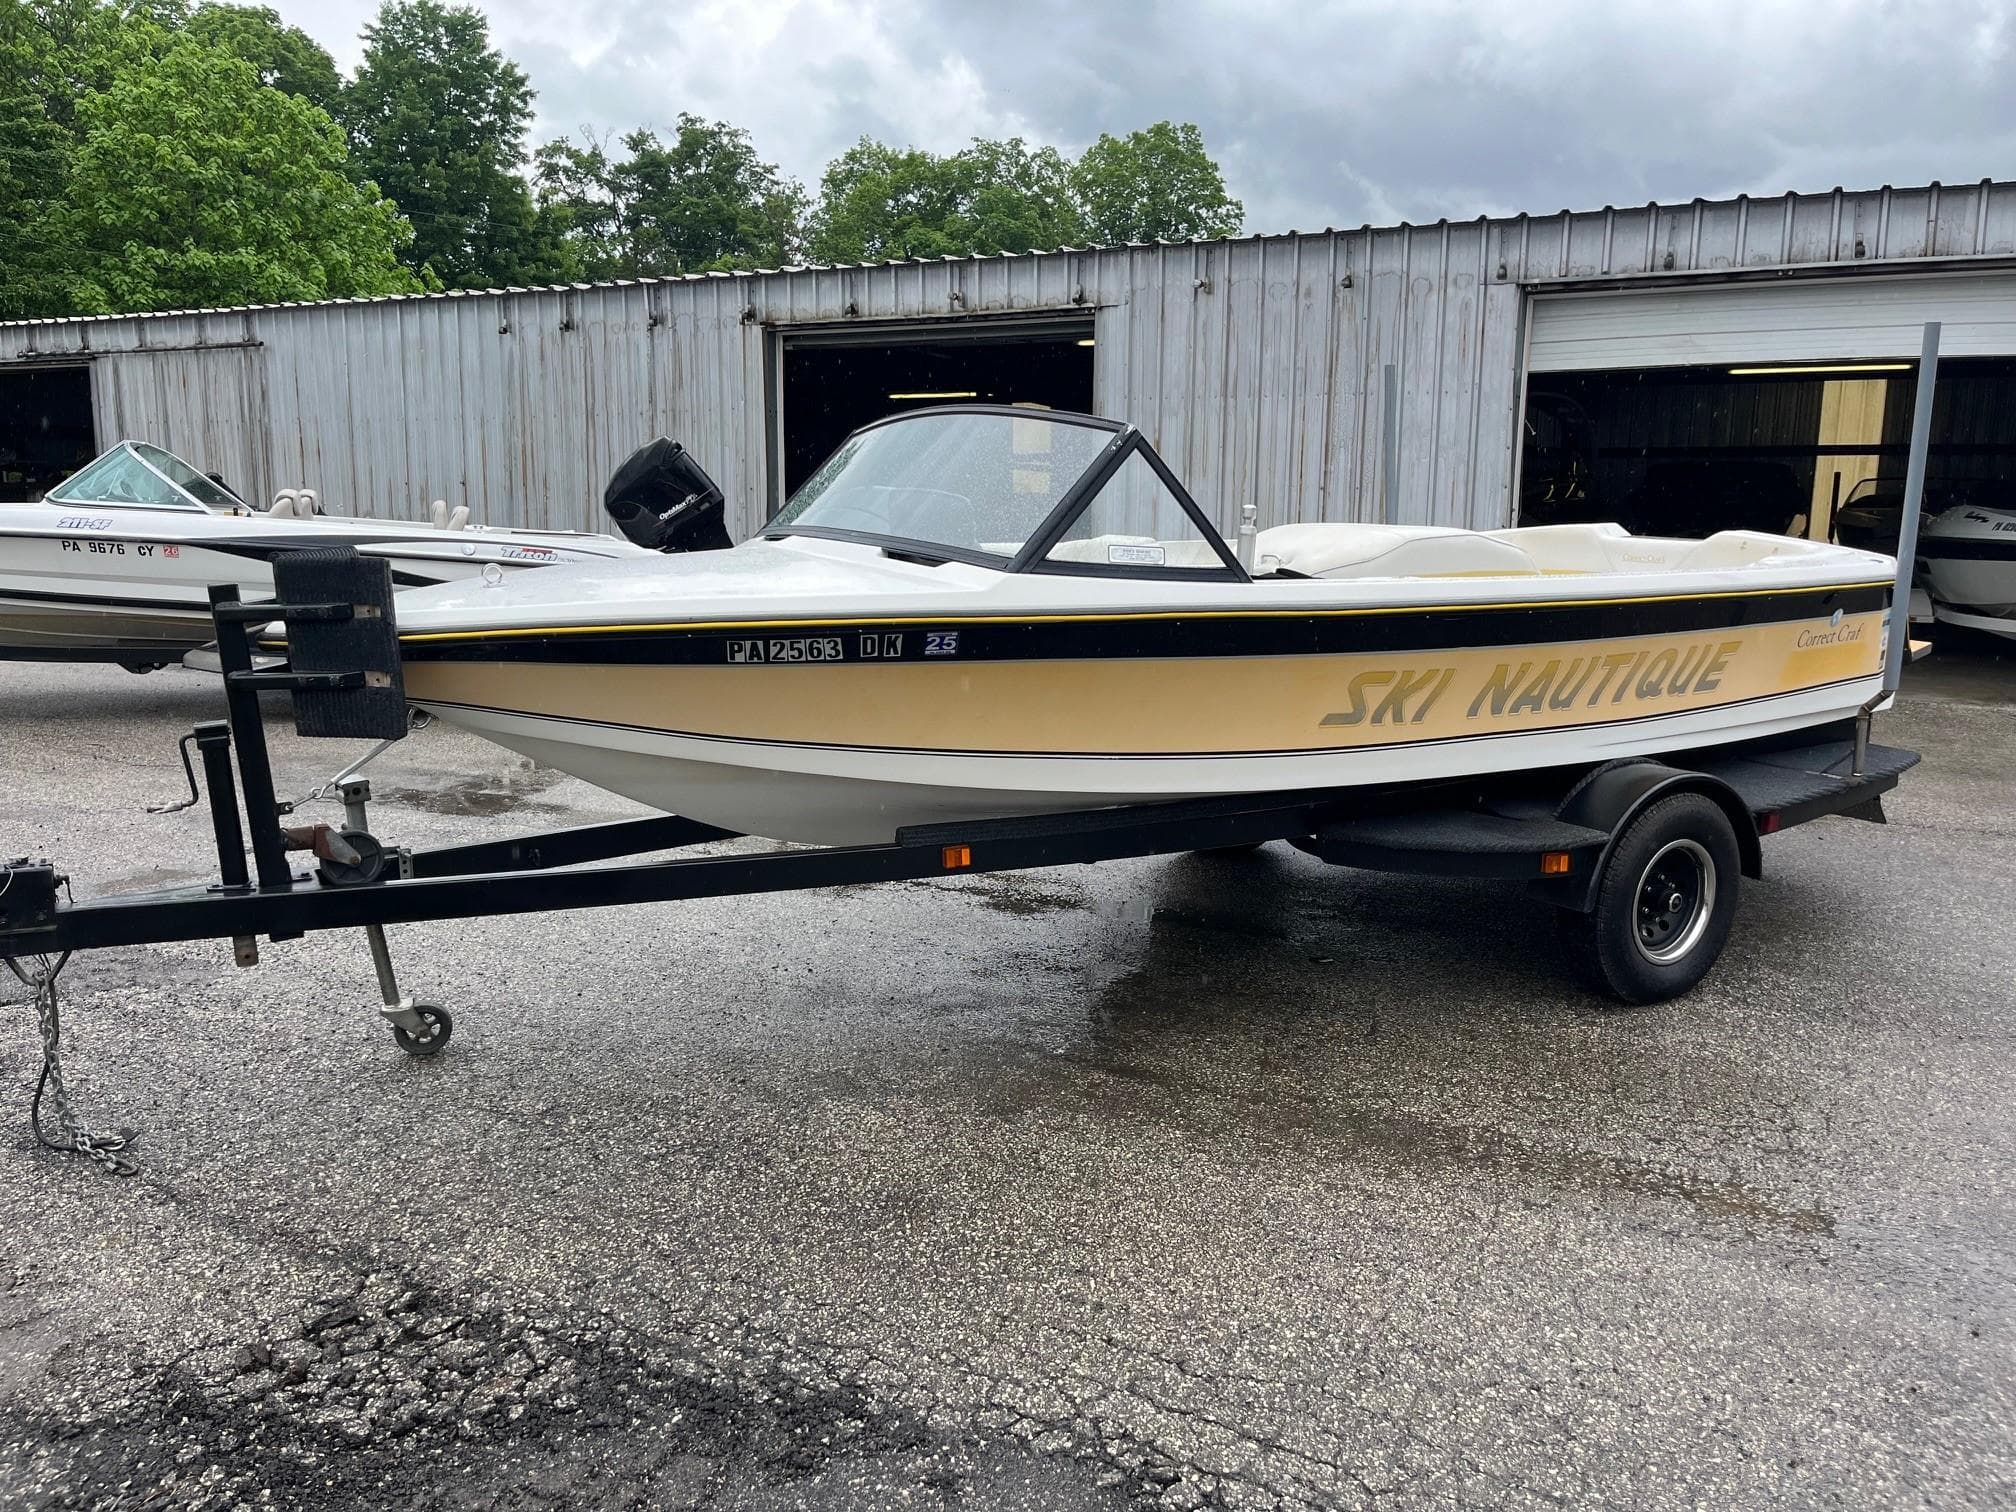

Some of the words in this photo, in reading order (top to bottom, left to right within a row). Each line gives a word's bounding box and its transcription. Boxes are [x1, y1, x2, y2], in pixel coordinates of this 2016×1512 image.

[61, 540, 81, 552] PA
[89, 542, 125, 555] 9676
[138, 545, 154, 557] CY
[728, 641, 764, 663] PA
[770, 638, 844, 662] 2563
[925, 636, 957, 651] 25
[1319, 668, 1456, 727] SKI
[1466, 640, 1743, 719] NAUTIQUE
